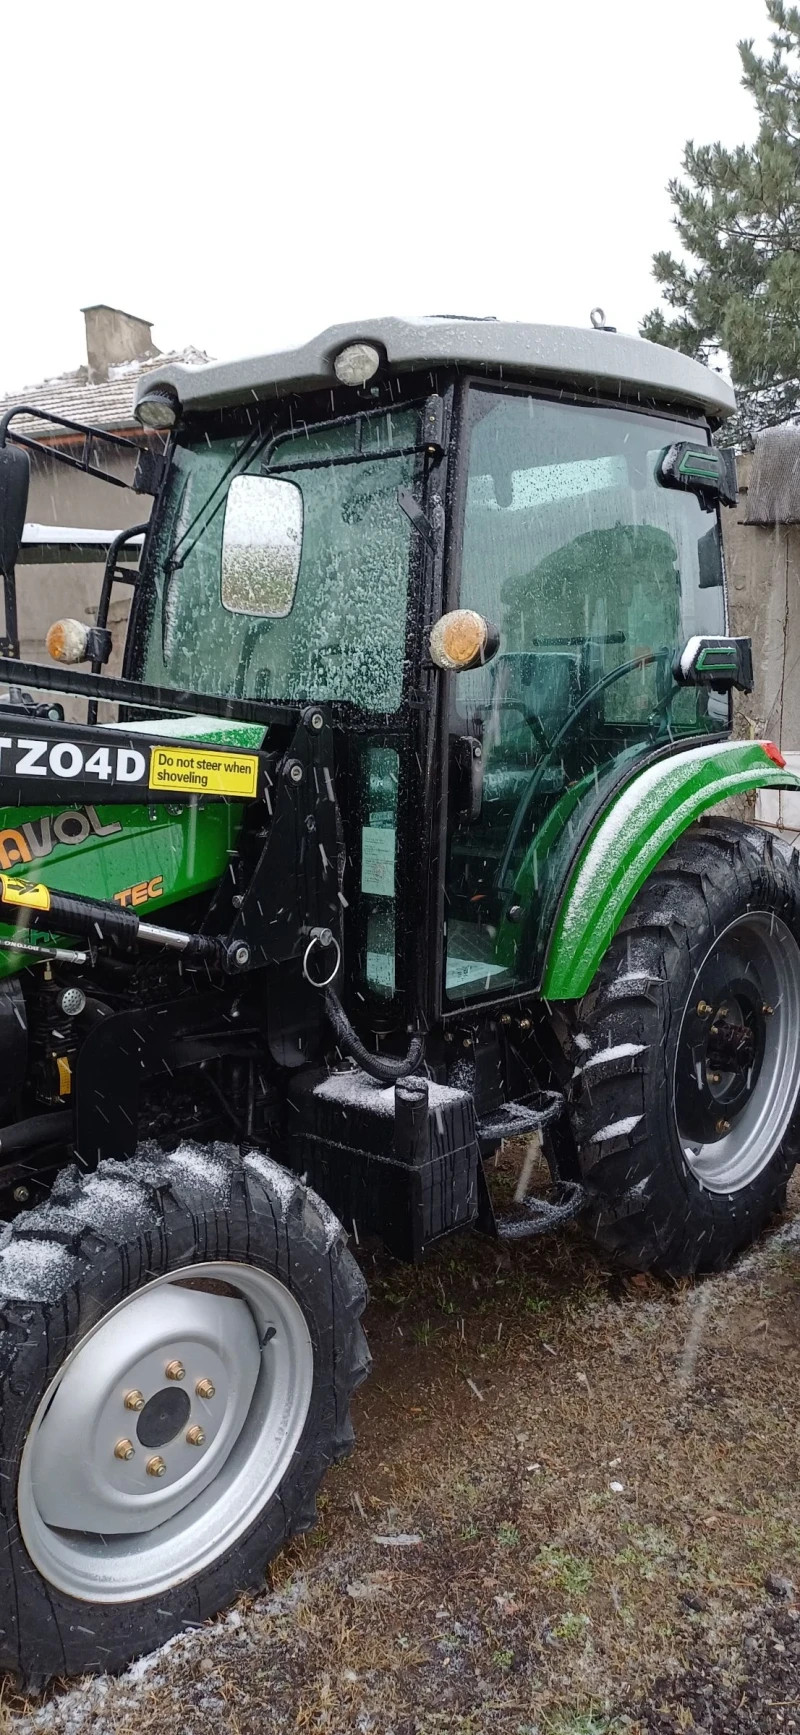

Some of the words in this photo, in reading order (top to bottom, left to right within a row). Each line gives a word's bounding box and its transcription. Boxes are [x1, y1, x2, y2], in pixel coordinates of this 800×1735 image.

[158, 753, 174, 767] Do
[176, 758, 195, 769] not
[196, 759, 222, 771] steer
[224, 761, 252, 775] when
[157, 769, 208, 787] shoveling
